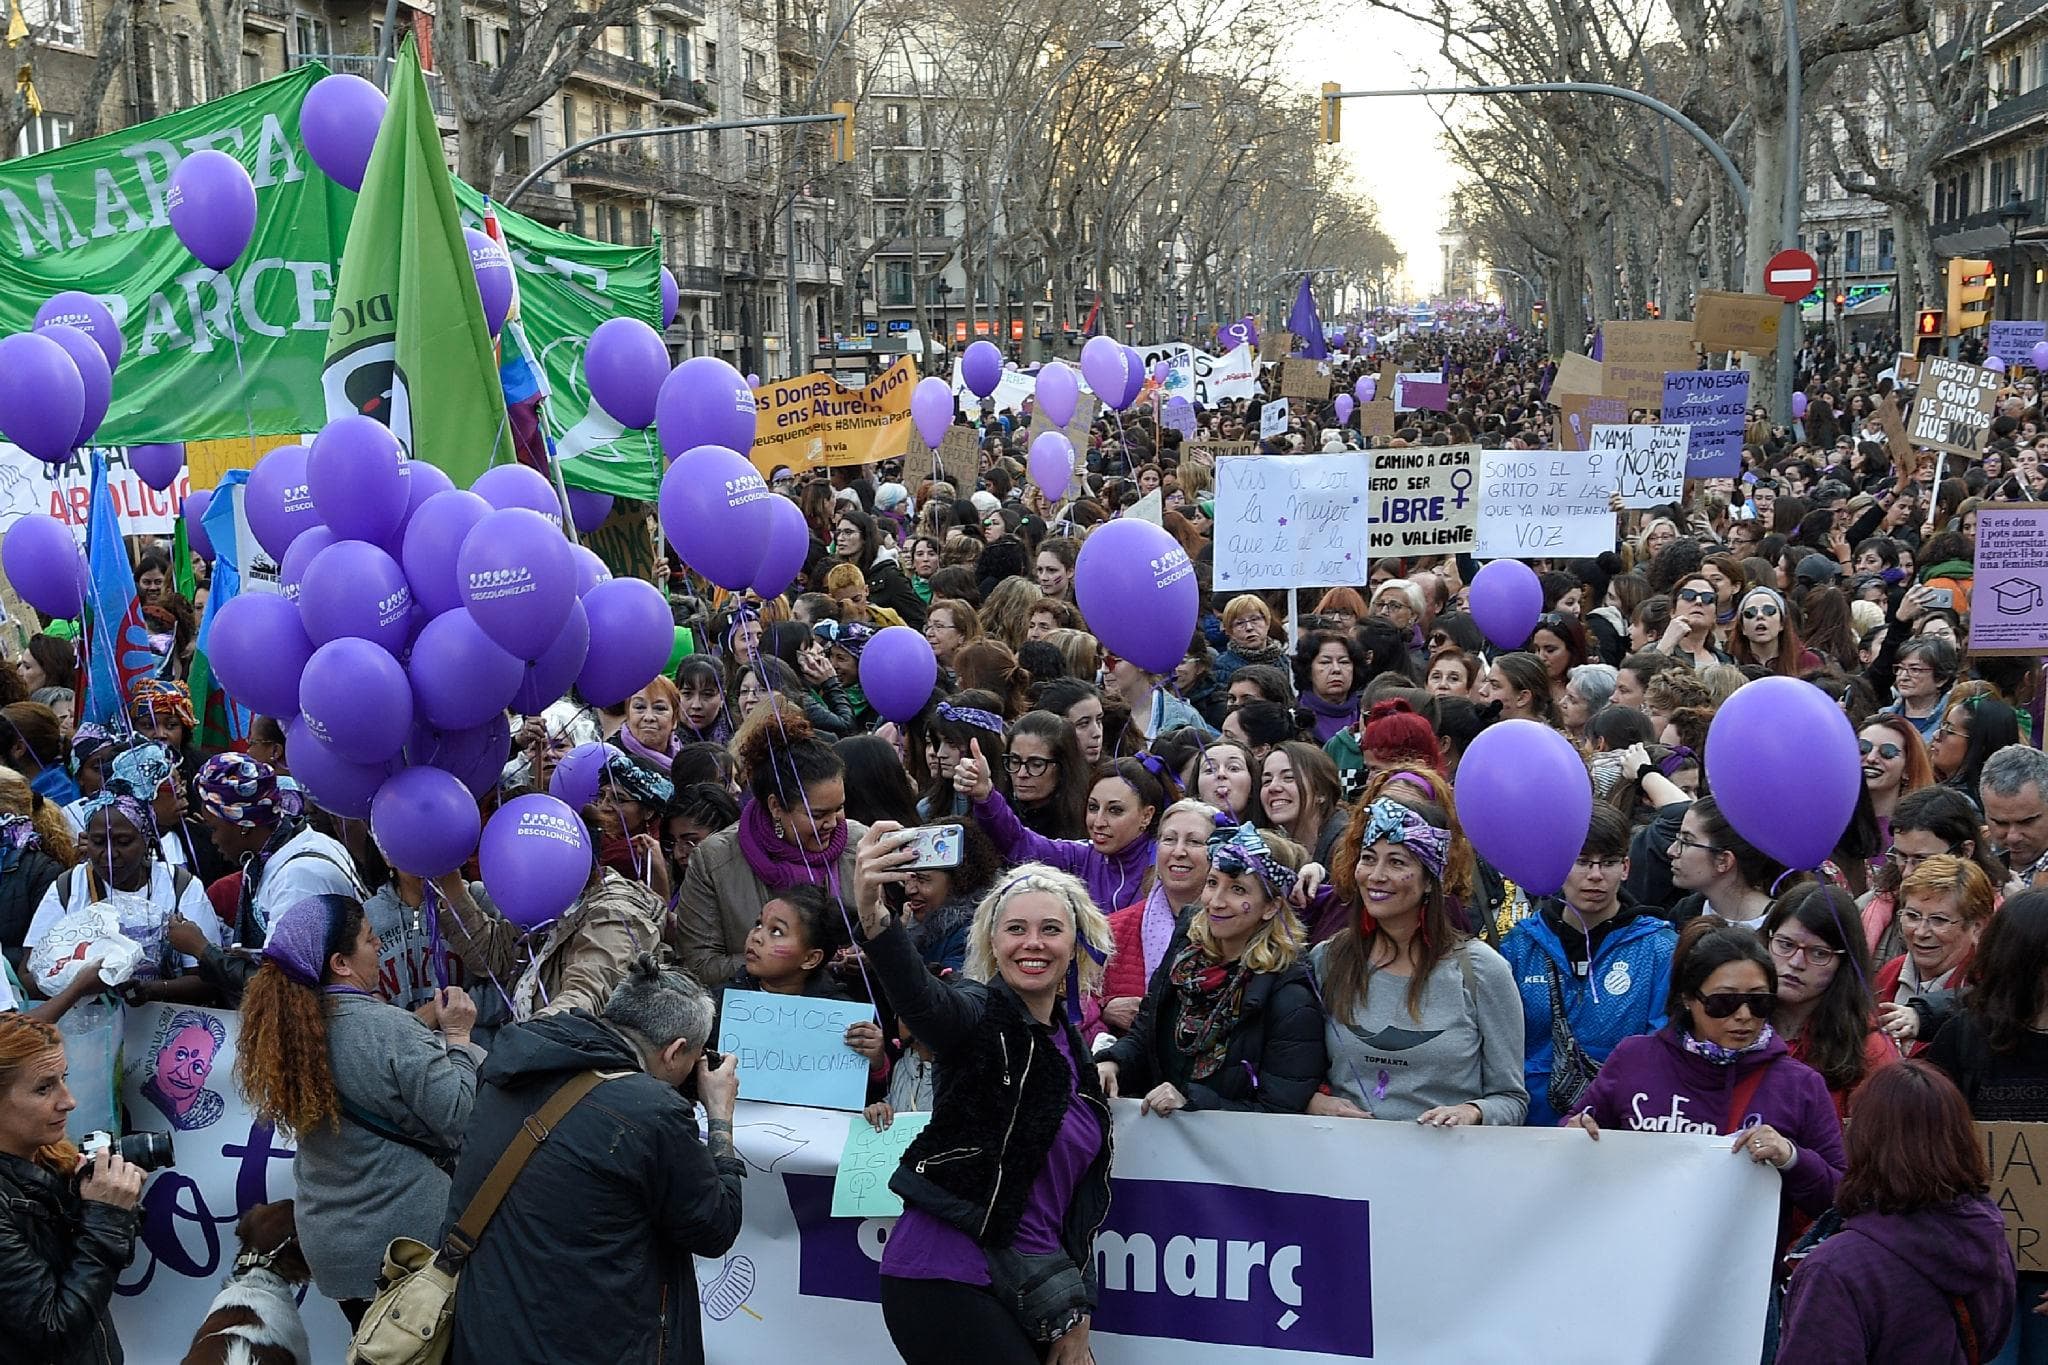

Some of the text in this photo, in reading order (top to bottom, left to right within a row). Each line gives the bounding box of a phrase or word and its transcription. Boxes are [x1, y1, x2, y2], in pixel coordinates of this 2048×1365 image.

[1667, 372, 1750, 390] HOY NO ESTÁN
[1930, 358, 1997, 391] HASTA EL
[775, 380, 831, 407] Dones
[870, 367, 909, 403] Món
[1936, 380, 1981, 408] COÑO
[777, 407, 808, 427] ens
[1665, 403, 1745, 419] NUESTRAS VOCES
[1918, 397, 1991, 429] DE TANTOS
[1594, 428, 1634, 450] MAMÁ
[1914, 415, 1981, 451] HUEVOX
[1650, 438, 1681, 453] QUILA
[1427, 454, 1435, 467] A
[1439, 451, 1470, 466] CASA
[1652, 450, 1678, 470] VOY
[1486, 461, 1571, 478] SOMOS EL
[1651, 470, 1683, 482] POR LA
[1407, 476, 1431, 490] SER
[1488, 482, 1610, 499] GRITO DE LAS
[1647, 483, 1681, 498] CALLE
[1236, 493, 1264, 523] la
[1485, 505, 1608, 517] QUE YA NO TIENEN
[1981, 517, 2036, 527] Si ets dona
[1371, 532, 1394, 547] NO
[1515, 523, 1564, 548] VOZ
[1981, 529, 1985, 538] i
[1988, 529, 2010, 540] pots
[2012, 530, 2035, 538] anar
[1981, 539, 1990, 548] la
[1228, 534, 1264, 563] que
[1271, 530, 1289, 553] te
[1324, 525, 1345, 549] la
[1236, 560, 1286, 585] gana
[1980, 561, 1998, 569] una
[725, 999, 846, 1033] SOMOS
[1363, 1055, 1409, 1067] TOPMANTA
[1095, 1229, 1303, 1331] març
